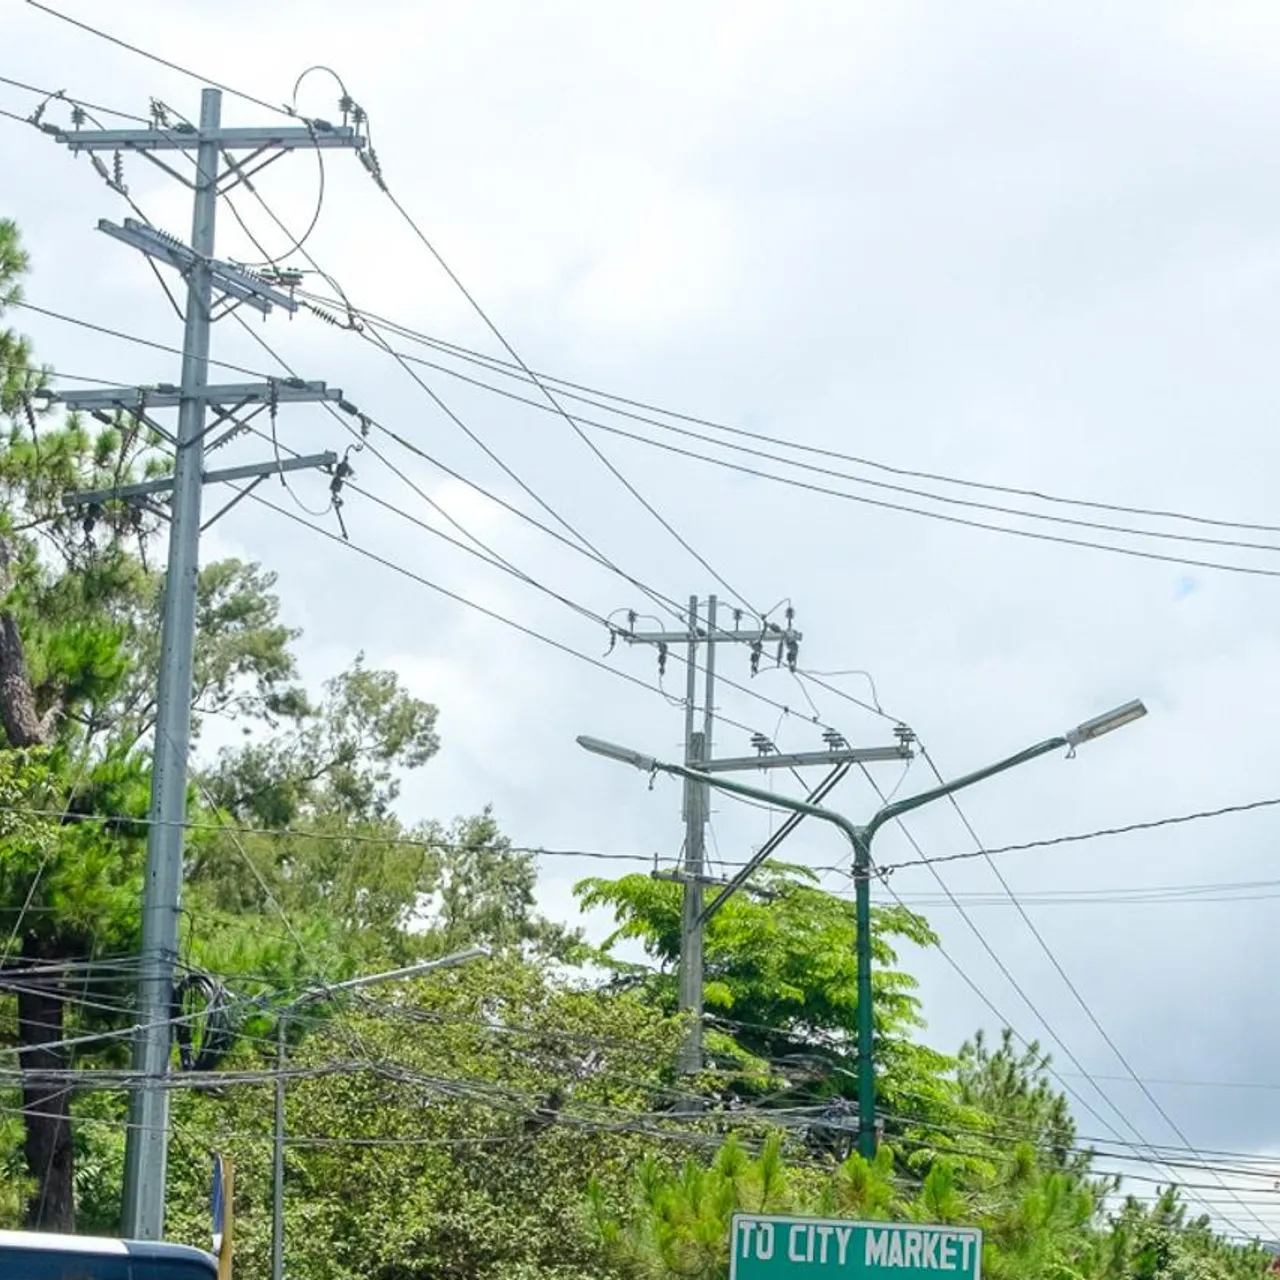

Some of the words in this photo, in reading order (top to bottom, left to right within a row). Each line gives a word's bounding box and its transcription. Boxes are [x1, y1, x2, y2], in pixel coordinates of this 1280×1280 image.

[739, 1221, 775, 1260] TO
[788, 1225, 852, 1265] CITY
[865, 1229, 975, 1271] MARKET
